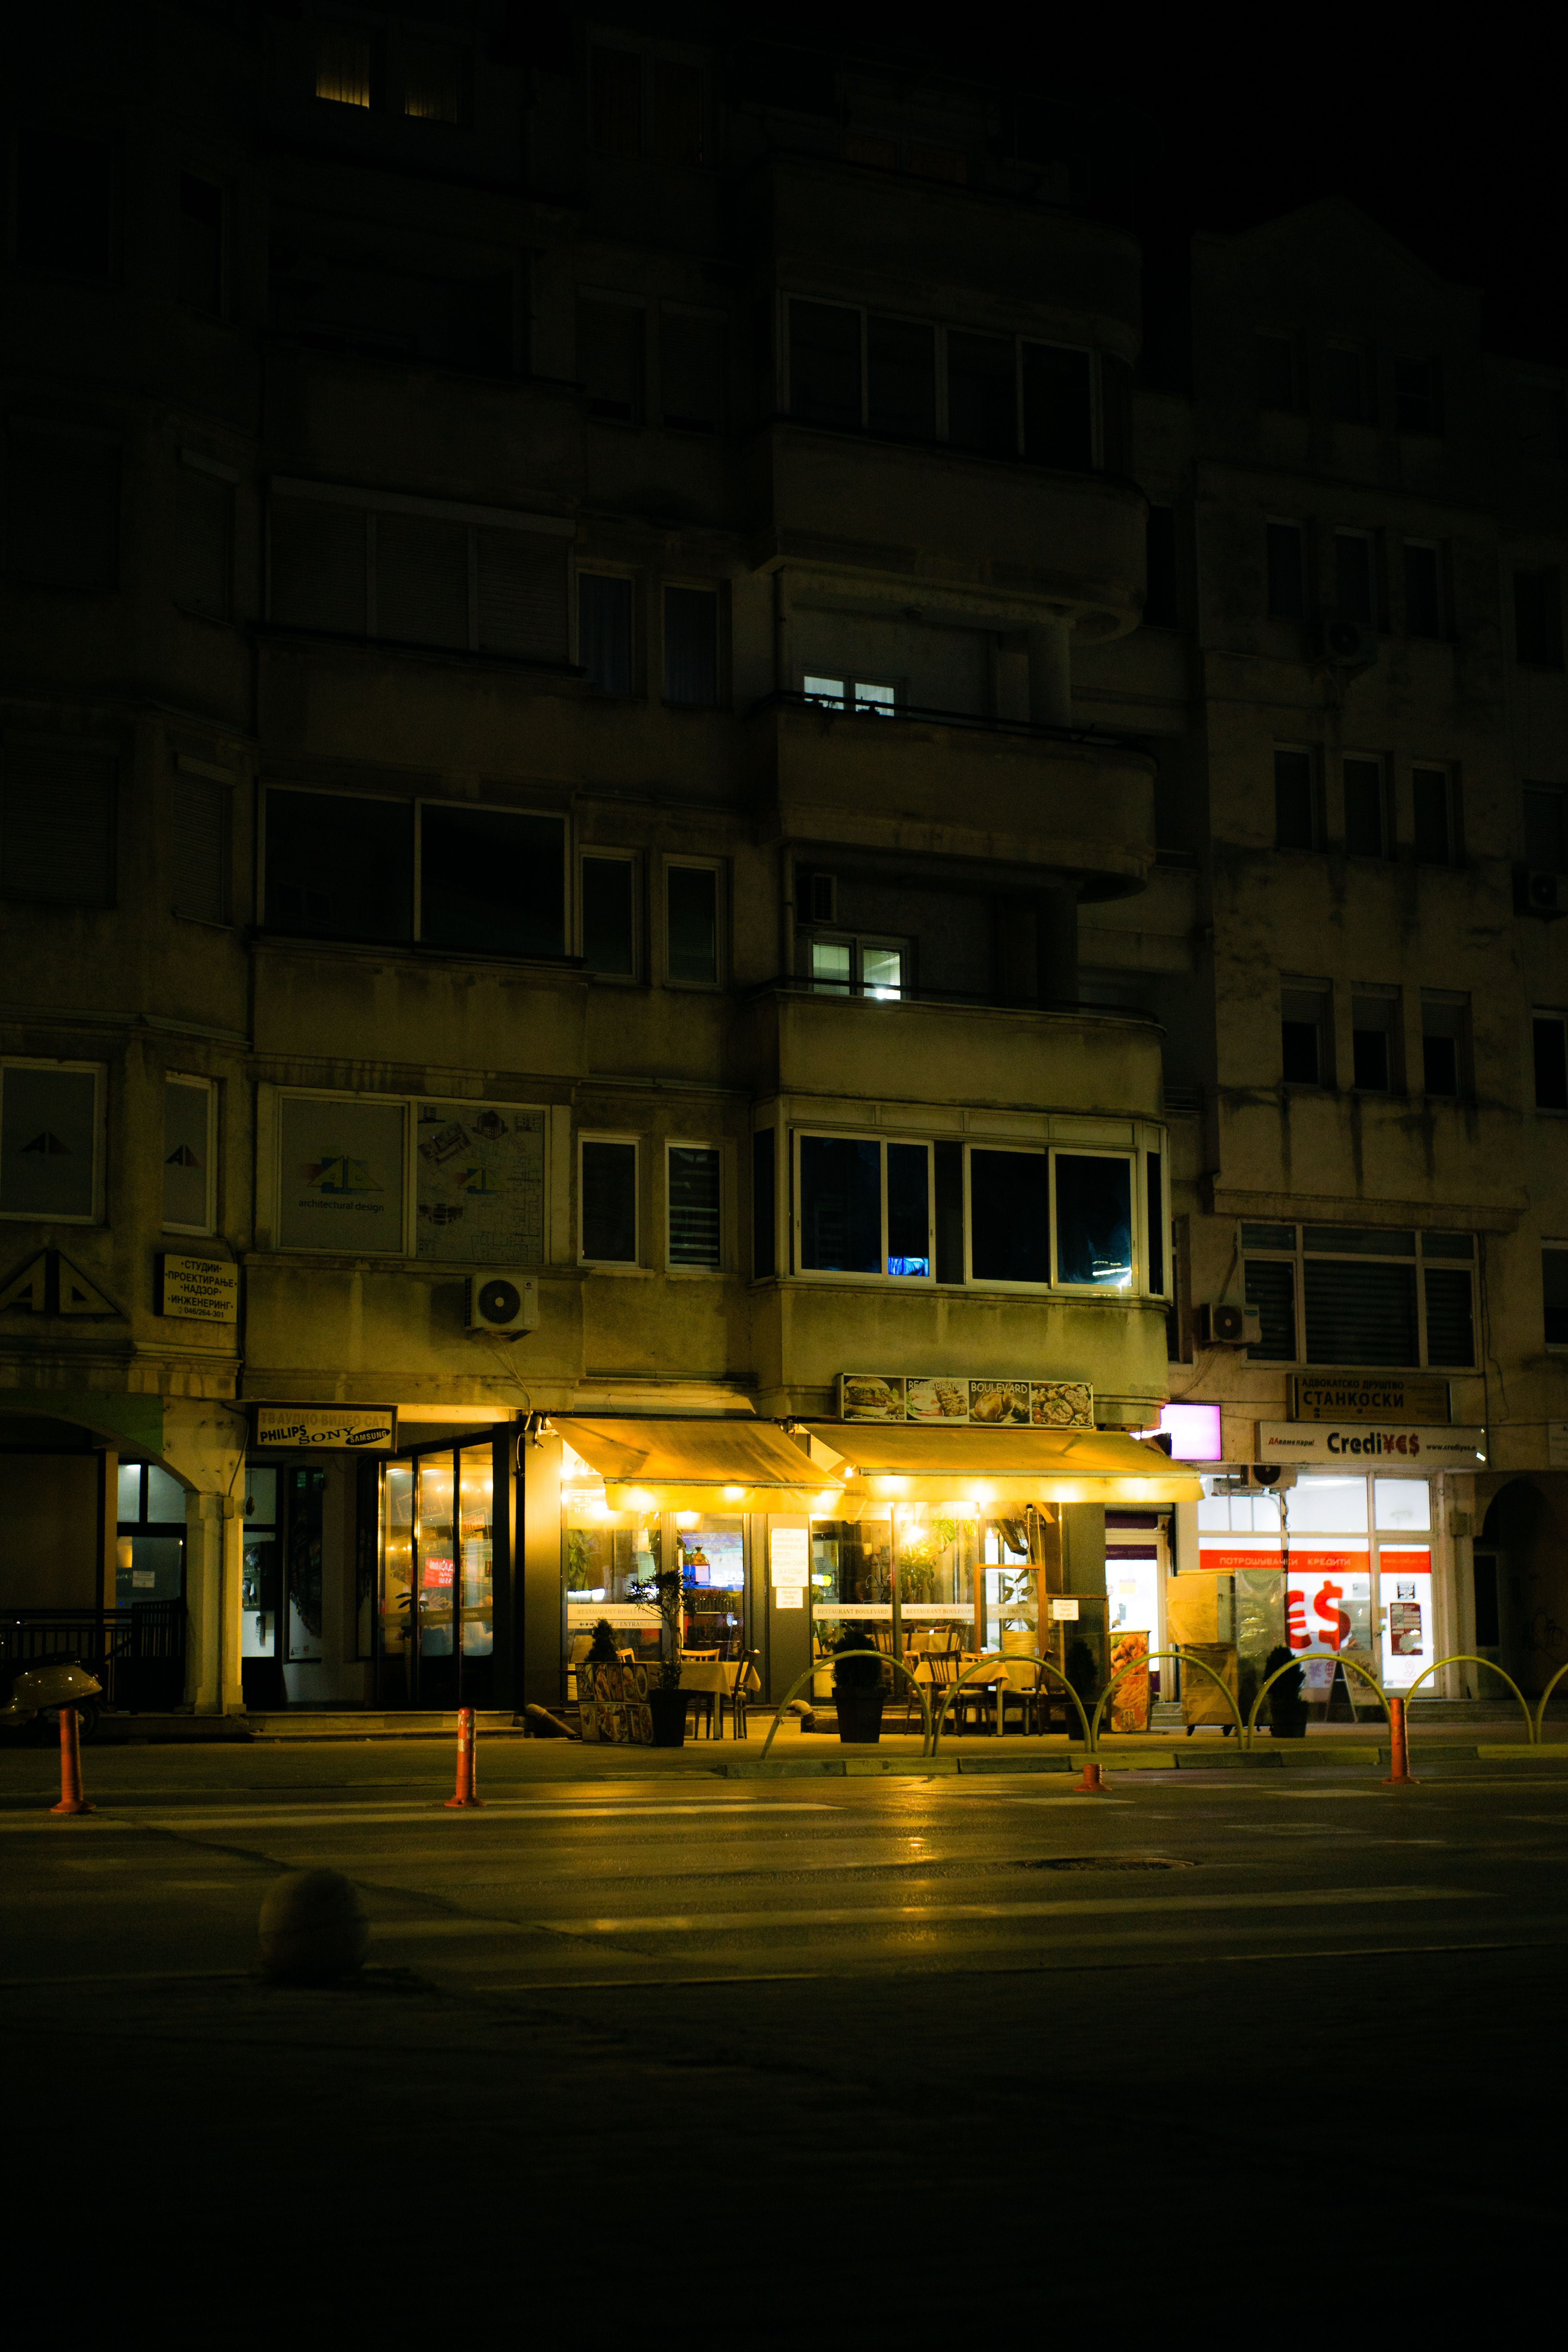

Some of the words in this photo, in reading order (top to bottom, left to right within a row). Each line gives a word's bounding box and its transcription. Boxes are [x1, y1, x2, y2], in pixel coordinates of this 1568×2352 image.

[299, 1199, 353, 1209] architectural
[355, 1202, 384, 1213] design
[184, 1307, 224, 1318] 046/264-301
[909, 1381, 965, 1391] RESTAURANT
[971, 1382, 1027, 1394] BOULEVARD
[1302, 1379, 1360, 1389] АДВОКАТСКО
[1362, 1380, 1404, 1390] ДРУШТВО
[1303, 1391, 1404, 1407] СТАНКОСКИ
[260, 1425, 306, 1442] PHILIPS
[298, 1426, 355, 1445] SONY
[349, 1430, 387, 1443] SAMSUNG
